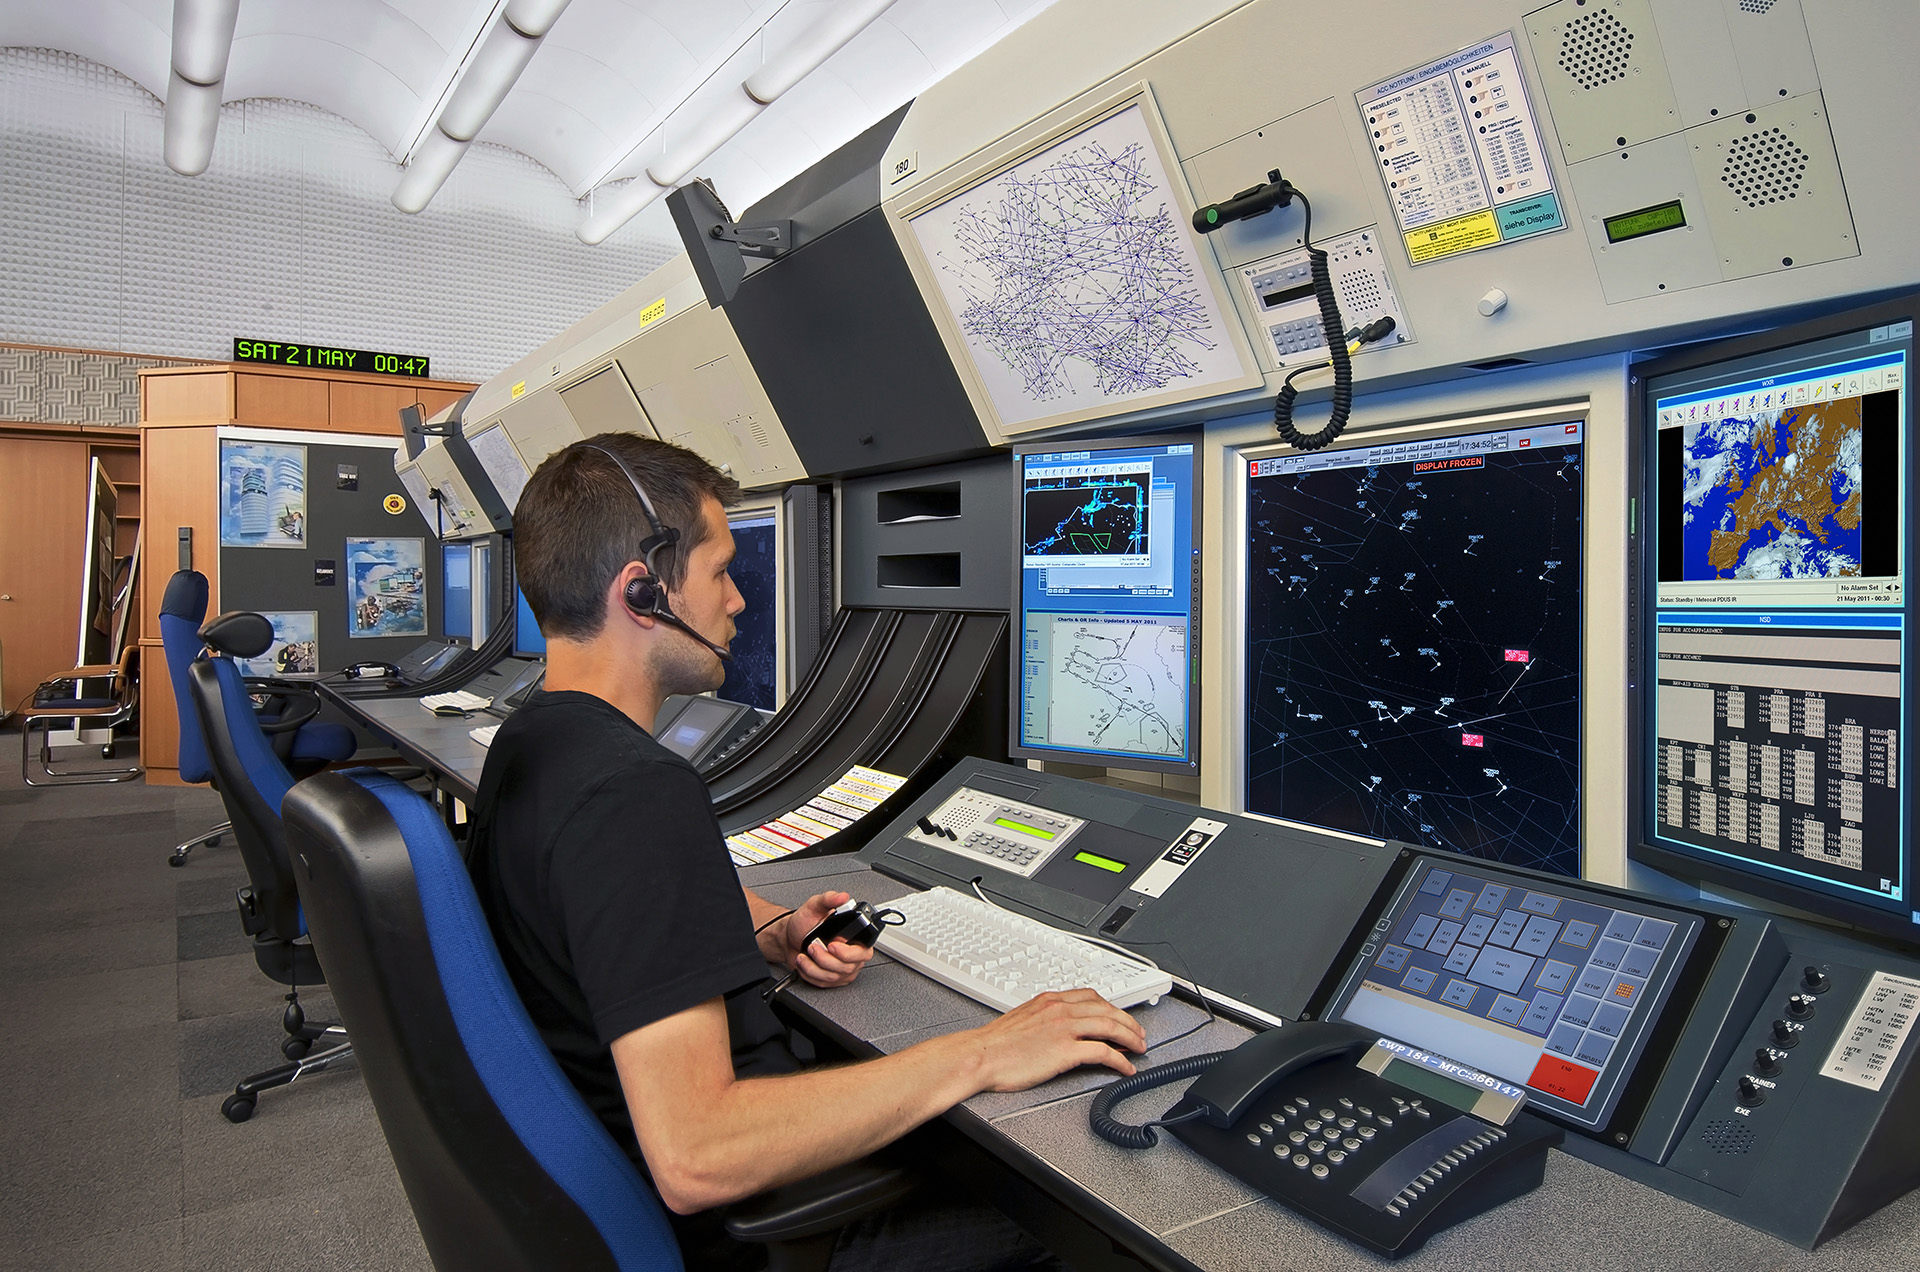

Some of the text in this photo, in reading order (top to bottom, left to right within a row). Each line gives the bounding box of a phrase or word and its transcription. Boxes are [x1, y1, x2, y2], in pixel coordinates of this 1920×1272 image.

[1376, 43, 1494, 95] ACC NOTFUNK EINGABEMÖGLICHKEITEN
[1466, 61, 1491, 74] MANUELL
[1370, 96, 1402, 111] PRESELECTED
[894, 158, 909, 175] 180
[1505, 211, 1555, 231] siehe Display
[237, 341, 427, 376] SAT 21 MAY 00:47
[1461, 440, 1491, 450] 17:34:52
[1415, 457, 1482, 472] DISPLAY FROZEN
[1844, 595, 1857, 603] May
[1584, 982, 1601, 991] SETUP
[1877, 986, 1897, 995] H/TW
[1866, 1006, 1885, 1014] H/TN
[1856, 1025, 1873, 1034] H/TS
[1845, 1046, 1862, 1054] H/TE
[1377, 1039, 1405, 1054] CWP
[1406, 1049, 1430, 1063] 184
[1438, 1061, 1521, 1098] MFC:366147
[1860, 1073, 1876, 1082] 1571
[1734, 1106, 1752, 1117] EXE
